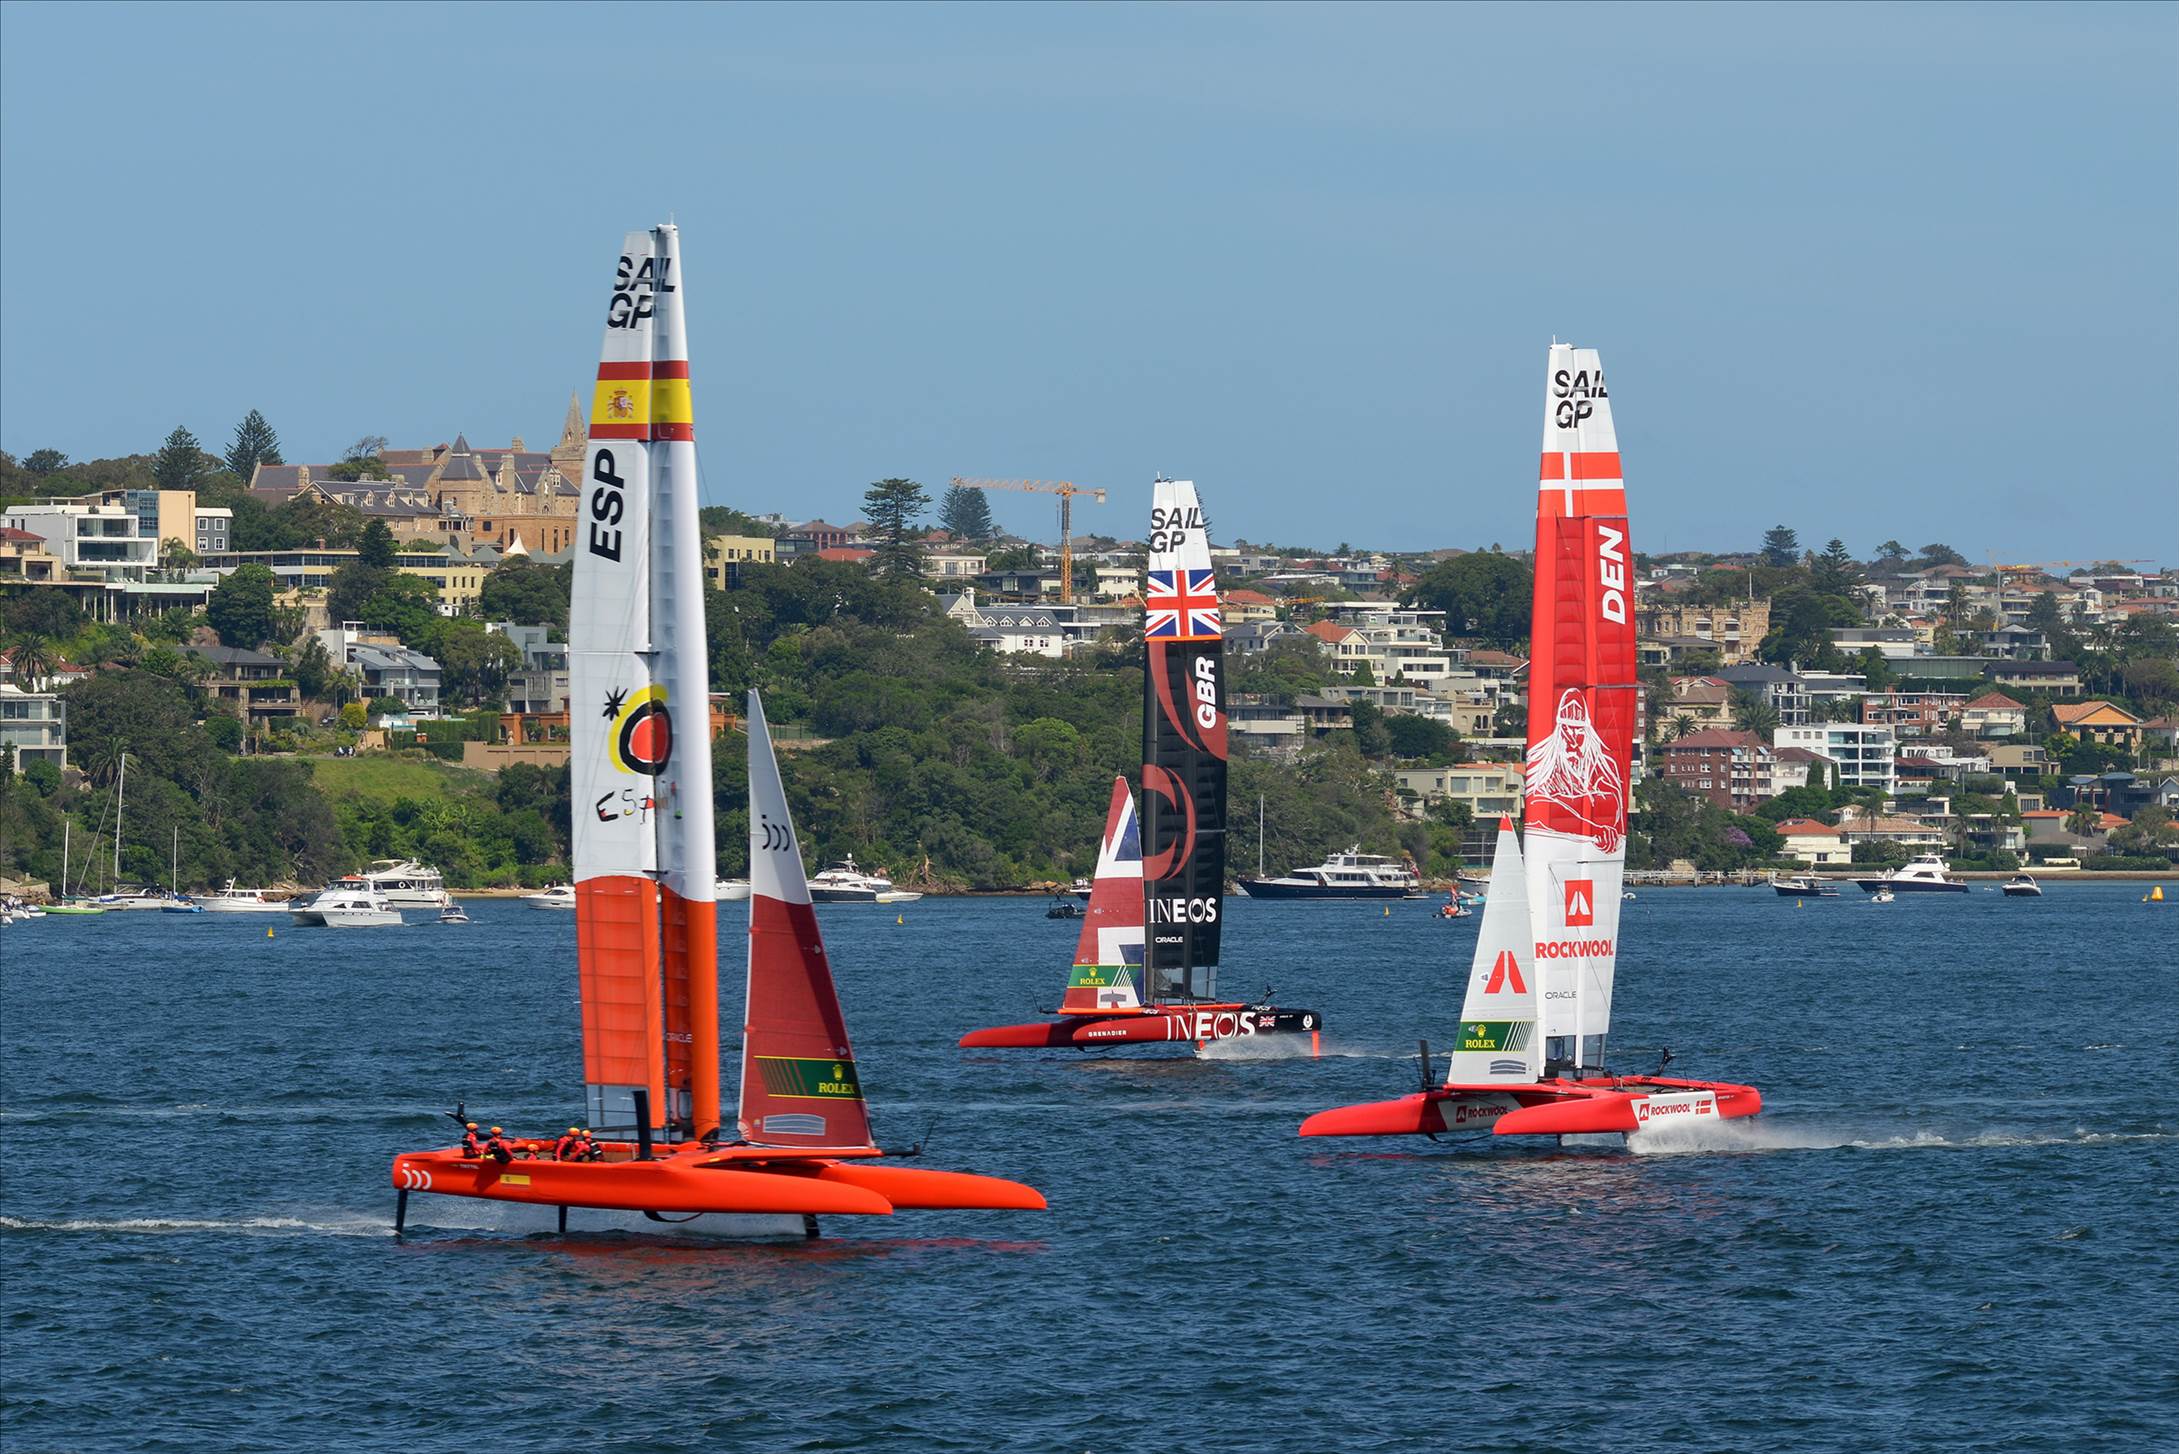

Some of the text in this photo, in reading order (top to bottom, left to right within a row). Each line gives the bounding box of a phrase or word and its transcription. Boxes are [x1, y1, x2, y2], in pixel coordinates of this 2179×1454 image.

[614, 256, 676, 292] SAIL
[607, 293, 657, 329] GP
[1553, 370, 1608, 398] SAIL
[1556, 400, 1593, 428] GP
[590, 448, 625, 563] ESP
[1151, 507, 1205, 530] SAIL
[1150, 531, 1186, 553] GP
[1599, 525, 1626, 625] DEN
[1195, 656, 1217, 729] GBR
[1148, 897, 1217, 924] INEOS
[1155, 936, 1184, 944] ORACLE
[1535, 938, 1614, 959] ROCKWOOL
[1079, 977, 1106, 985] ROLEX
[1544, 990, 1577, 1000] ORACLE
[1088, 1030, 1127, 1038] GRENADIER
[1165, 1012, 1256, 1041] INEOS
[1465, 1038, 1496, 1049] ROLEX
[818, 1082, 856, 1094] ROLEX
[1650, 1103, 1691, 1116] ROCKWOOL
